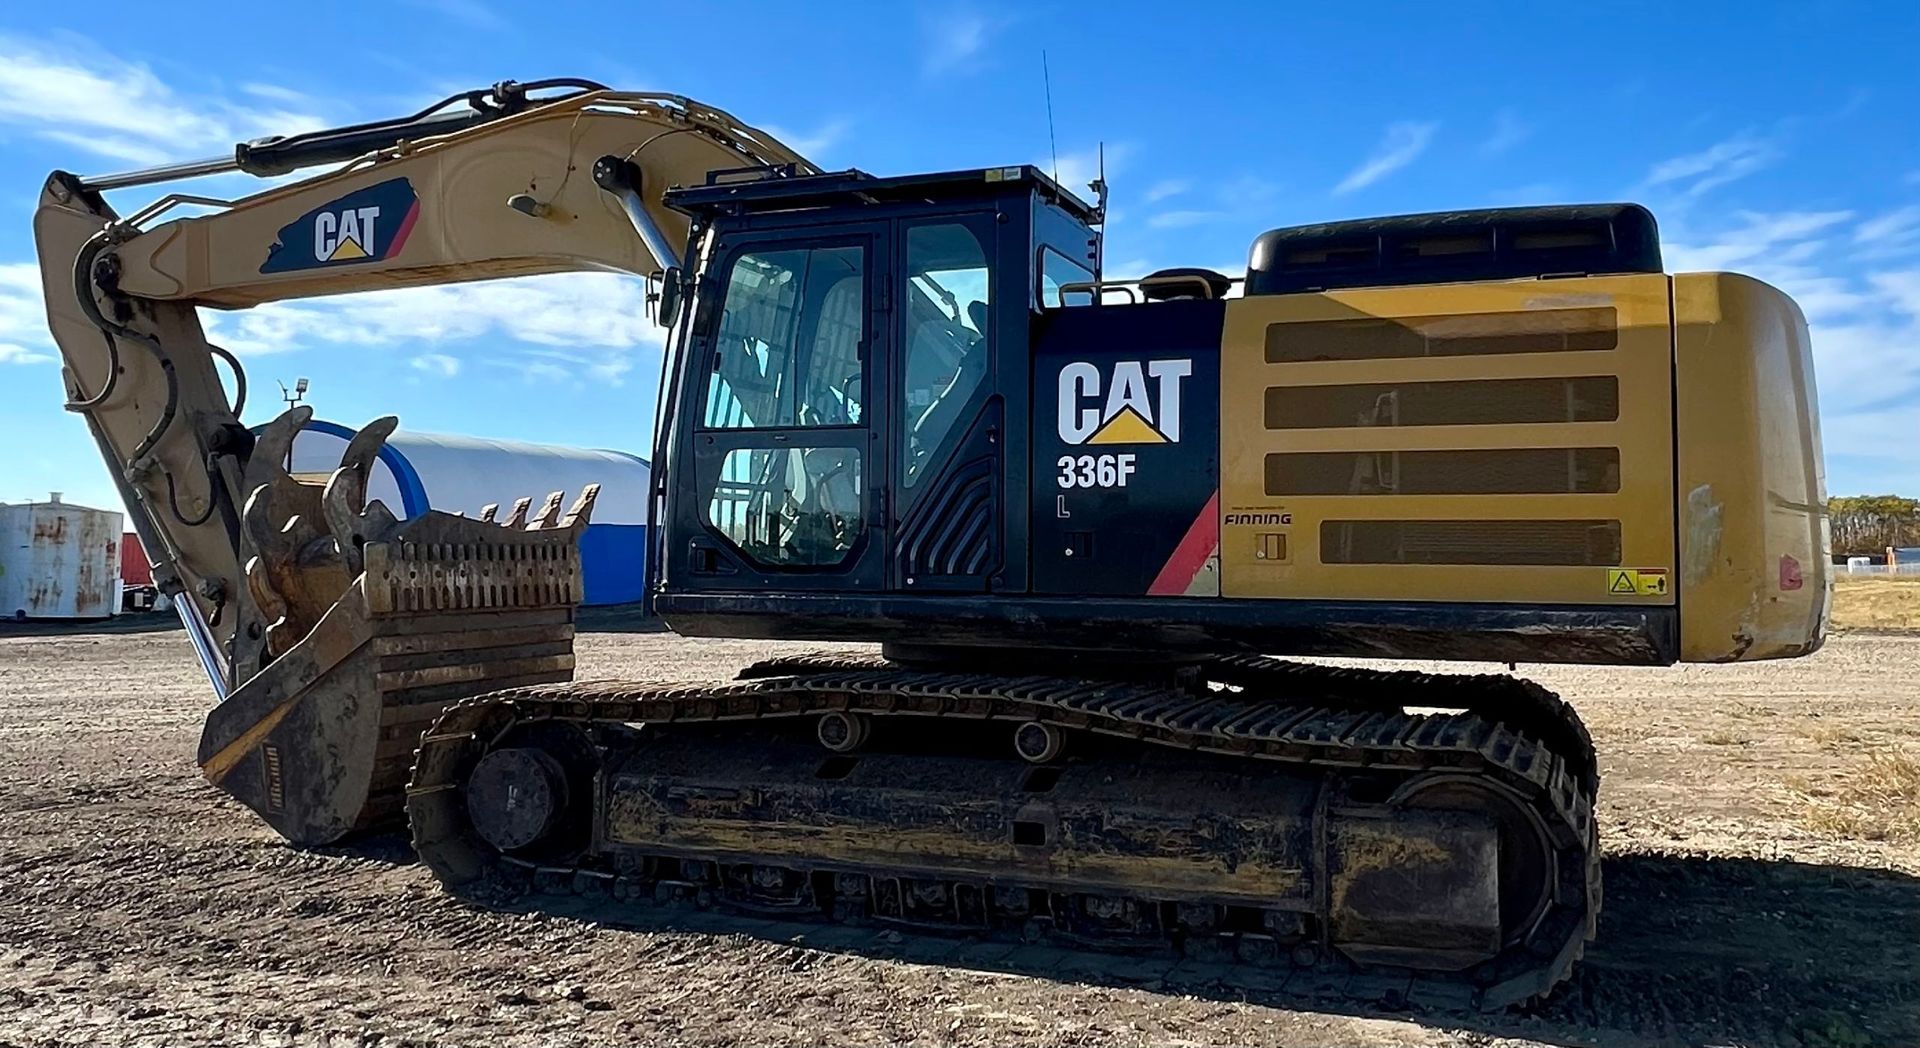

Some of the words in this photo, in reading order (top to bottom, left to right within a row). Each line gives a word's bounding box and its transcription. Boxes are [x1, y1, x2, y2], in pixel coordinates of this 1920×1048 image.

[315, 206, 379, 262] CAT
[1058, 359, 1192, 445] CAT
[1057, 454, 1136, 488] 336F
[1057, 495, 1071, 519] L
[1224, 514, 1292, 525] FINNING
